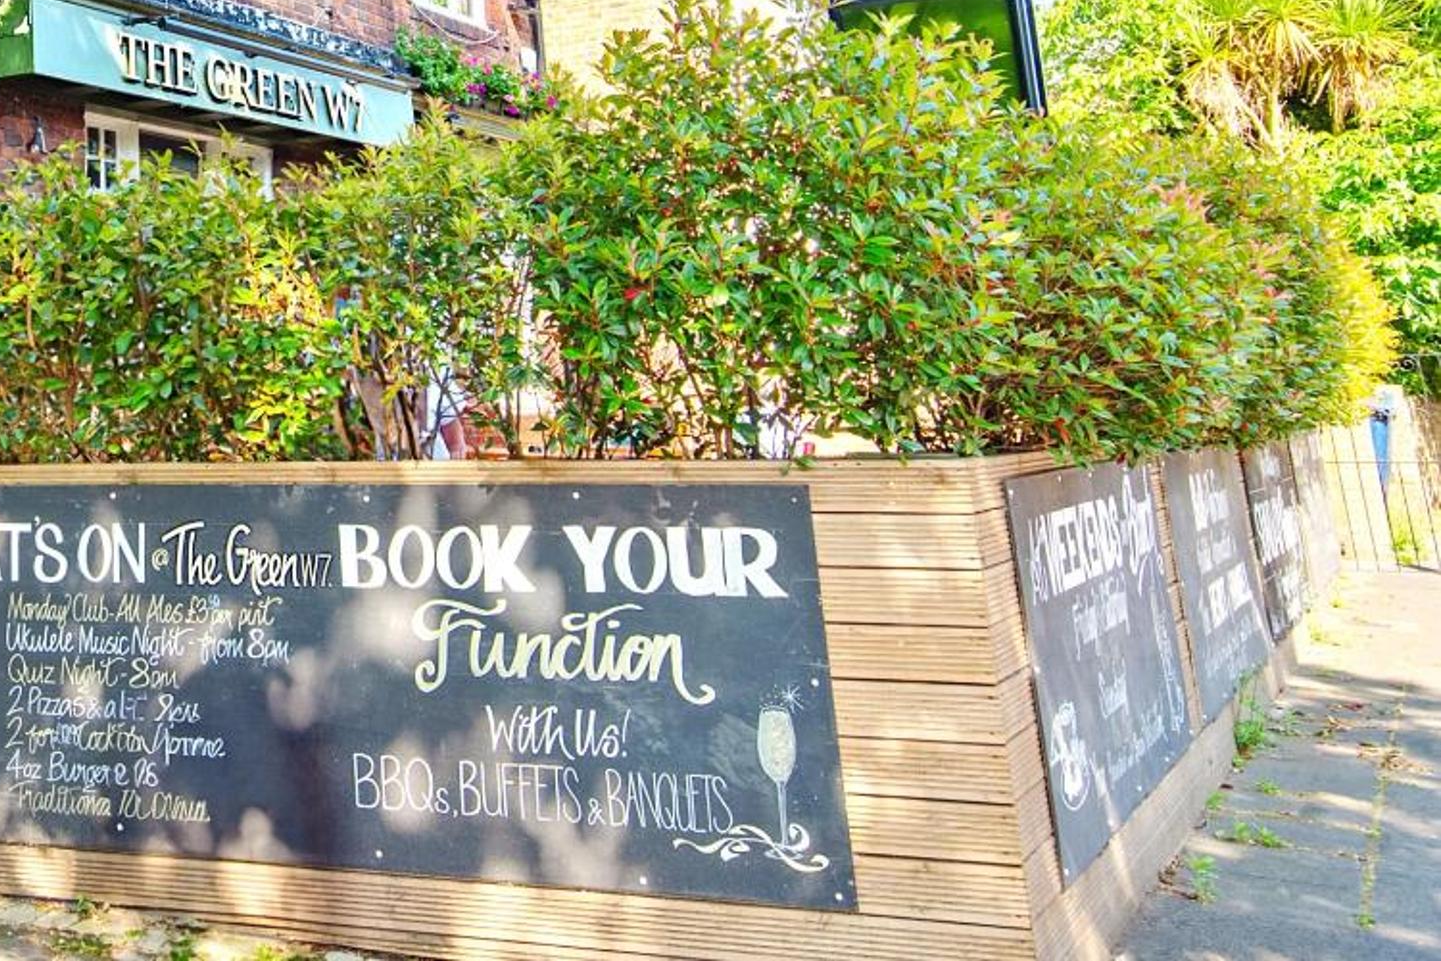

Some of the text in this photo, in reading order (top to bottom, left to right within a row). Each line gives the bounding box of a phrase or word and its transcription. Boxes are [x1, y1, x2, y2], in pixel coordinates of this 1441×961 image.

[118, 31, 199, 95] THE
[205, 53, 320, 127] GREEN
[76, 522, 146, 584] ON
[161, 519, 223, 587] The
[224, 523, 302, 595] Green
[338, 522, 789, 598] BOOK YOUR
[8, 592, 72, 627] Monday
[72, 593, 108, 623] Club
[115, 593, 142, 624] All
[5, 622, 75, 654] Ukulele
[78, 624, 130, 655] Music
[130, 624, 194, 667] Night
[197, 630, 244, 665] from
[246, 628, 290, 667] 8pm
[412, 598, 716, 705] Function
[7, 653, 56, 687] Quiz
[61, 656, 126, 694] Night
[6, 686, 24, 716] 2
[28, 686, 86, 719] Pizzas
[6, 716, 24, 748] 2
[485, 704, 631, 760] With Us!
[48, 751, 110, 792] Burger
[459, 759, 582, 825] BUFFETS
[587, 797, 607, 825] &
[604, 768, 733, 833] BANQUETS
